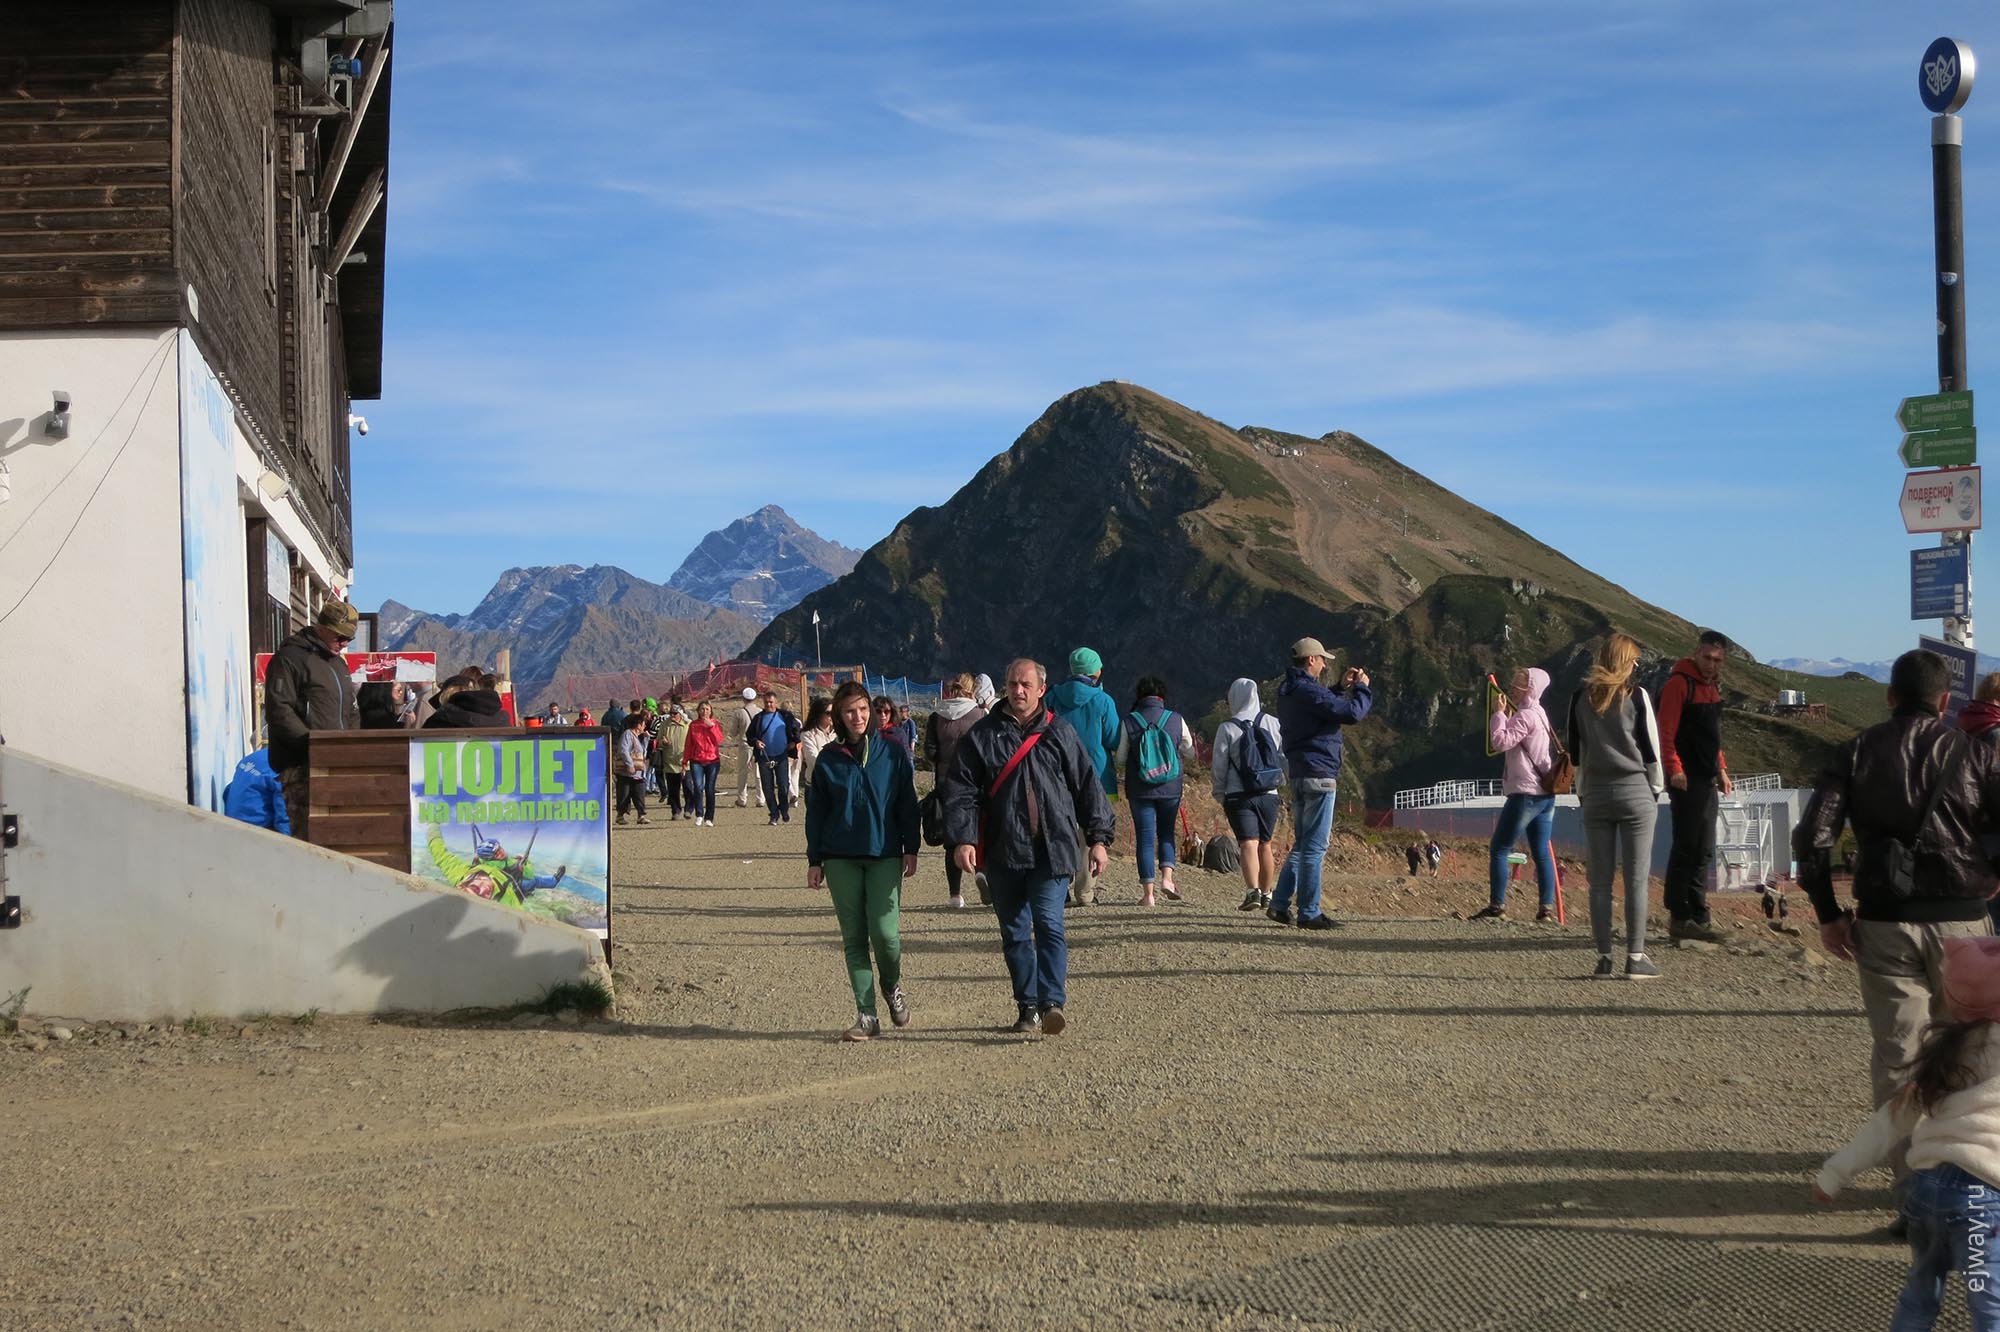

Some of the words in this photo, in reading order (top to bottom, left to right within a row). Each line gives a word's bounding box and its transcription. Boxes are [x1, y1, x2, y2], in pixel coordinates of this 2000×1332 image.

[1908, 482, 1954, 502] ПОДВЕСНОЙ
[1920, 506, 1941, 520] МОСТ
[423, 739, 596, 796] ПОЛЕТ
[419, 801, 450, 824] на
[455, 799, 601, 825] параплане
